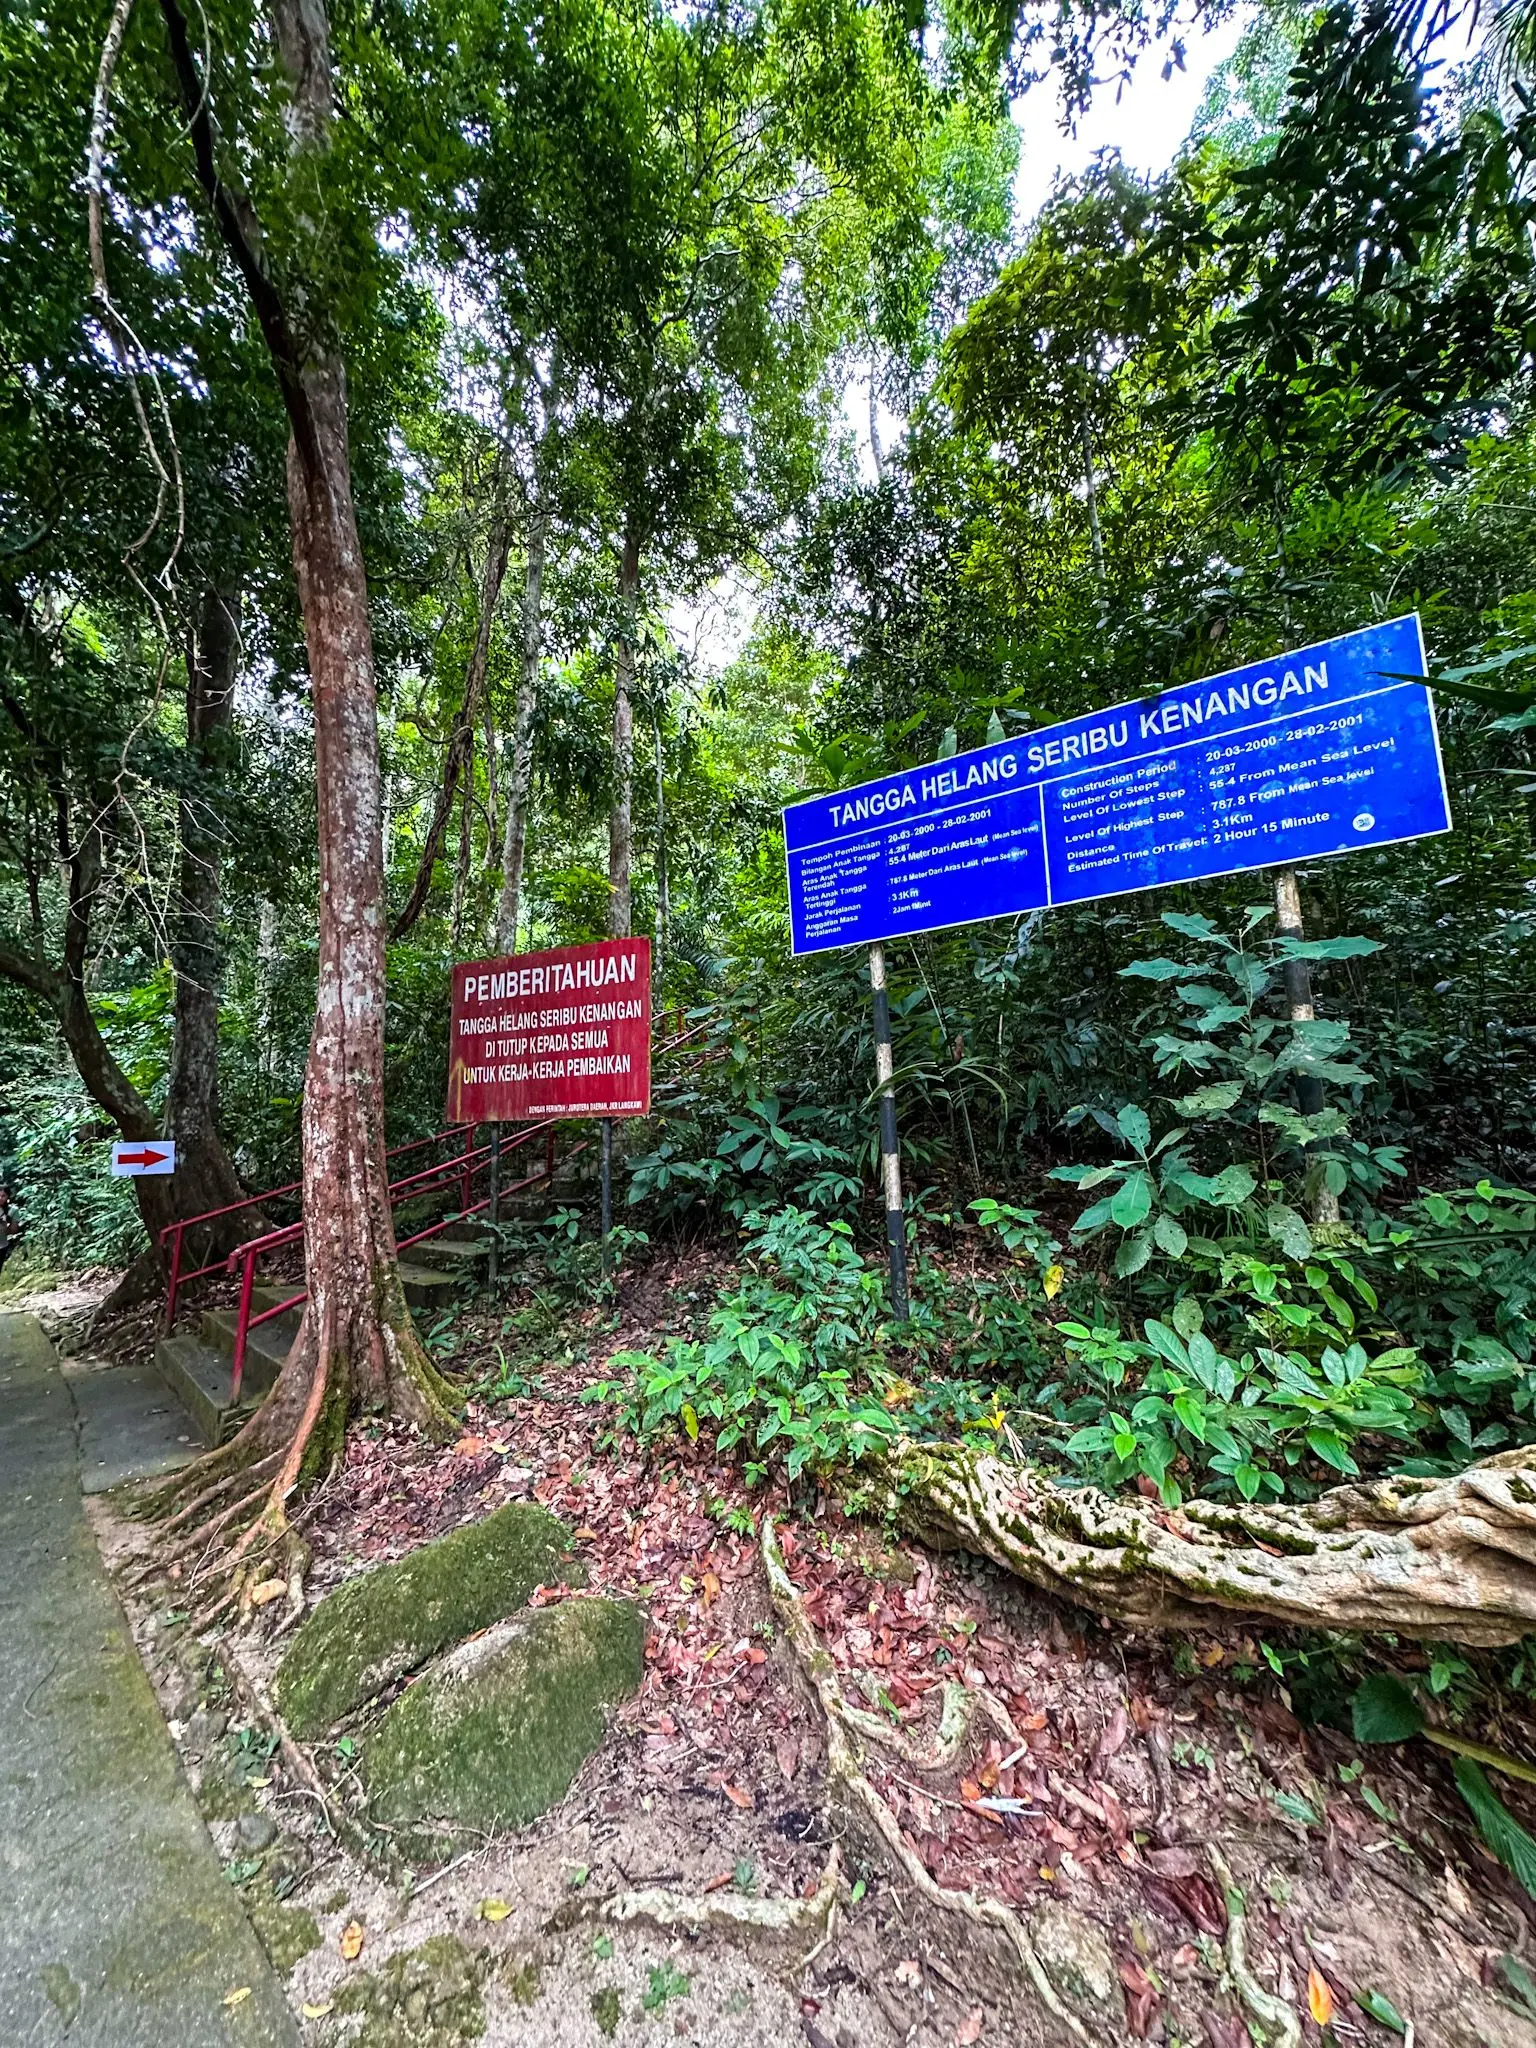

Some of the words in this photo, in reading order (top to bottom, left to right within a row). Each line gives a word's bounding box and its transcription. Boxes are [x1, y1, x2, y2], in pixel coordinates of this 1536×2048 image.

[829, 785, 917, 828] TANGGA
[921, 755, 1018, 801] HELANG
[1027, 720, 1128, 774] SERIBU
[1140, 661, 1329, 739] KENANGAN
[1061, 773, 1133, 798] Construction
[1137, 761, 1176, 779] Period
[1206, 736, 1277, 762] 20-03-2000
[1286, 713, 1364, 741] 28-02-2001
[1062, 794, 1106, 810] Number
[1109, 789, 1123, 799] Of
[1125, 781, 1160, 795] Steps
[1063, 809, 1093, 823] Level
[1096, 805, 1110, 815] Of
[1112, 795, 1155, 812] Lowest
[1157, 788, 1186, 802] Step
[1239, 768, 1275, 783] From
[1278, 758, 1317, 773] Mean
[1321, 751, 1349, 763] Sea
[1353, 737, 1395, 755] Level
[1065, 830, 1094, 843] Level
[1097, 825, 1111, 836] Of
[1113, 815, 1154, 833] Highest
[1157, 810, 1185, 823] Step
[1211, 796, 1246, 811] 787.8
[1250, 788, 1285, 803] From
[1288, 780, 1319, 793] Mean
[1321, 774, 1345, 786] Sea
[1346, 766, 1375, 781] level
[801, 853, 833, 865] Tempoh
[835, 840, 880, 857] Pembinaan
[888, 824, 935, 843] 20-03-2000
[942, 809, 991, 829] 28-02-2001
[1067, 844, 1115, 860] Distance
[1212, 813, 1253, 829] 3.1Km
[1068, 854, 1120, 873] Estimated
[1122, 848, 1149, 861] Time
[1152, 844, 1166, 855] Of
[1213, 833, 1222, 844] 2
[1225, 827, 1258, 842] Hour
[1262, 821, 1278, 834] 15
[1281, 812, 1330, 830] Minute
[801, 864, 832, 876] Bilangan
[833, 858, 851, 868] Anak
[853, 851, 881, 863] Tangga
[802, 877, 818, 887] Aras
[820, 872, 838, 882] Anak
[840, 865, 867, 877] Tangga
[908, 849, 930, 861] Meter
[932, 843, 950, 856] Dari
[950, 839, 970, 850] Aras
[970, 834, 988, 846] Laut
[1010, 828, 1022, 837] Sea
[803, 894, 819, 904] Aras
[820, 889, 839, 899] Anak
[840, 883, 867, 895] Tangga
[909, 871, 928, 881] Meter
[928, 867, 943, 877] Dari
[944, 863, 961, 873] Aras
[962, 859, 979, 869] Laut
[1000, 852, 1011, 861] Sea
[803, 880, 835, 893] Terendah
[805, 898, 836, 910] Tertinggi
[804, 912, 823, 921] Jarak
[824, 903, 861, 916] Perjalanan
[806, 919, 838, 931] Anggaran
[840, 914, 858, 924] Masa
[806, 926, 841, 938] Perjalanan
[464, 954, 636, 1002] PEMBERITAHUAN
[459, 1017, 498, 1036] TANGGA
[499, 1011, 538, 1032] HELANG
[540, 1007, 577, 1028] SERIBU
[579, 1000, 642, 1023] KENANGAN
[485, 1041, 496, 1058] DI
[497, 1038, 528, 1057] TUTUP
[530, 1033, 570, 1054] KEPADA
[571, 1030, 609, 1050] SEMUA
[463, 1066, 497, 1084] UNTUK
[499, 1060, 565, 1082] KERJA-KERJA
[567, 1054, 631, 1077] PEMBAIKAN
